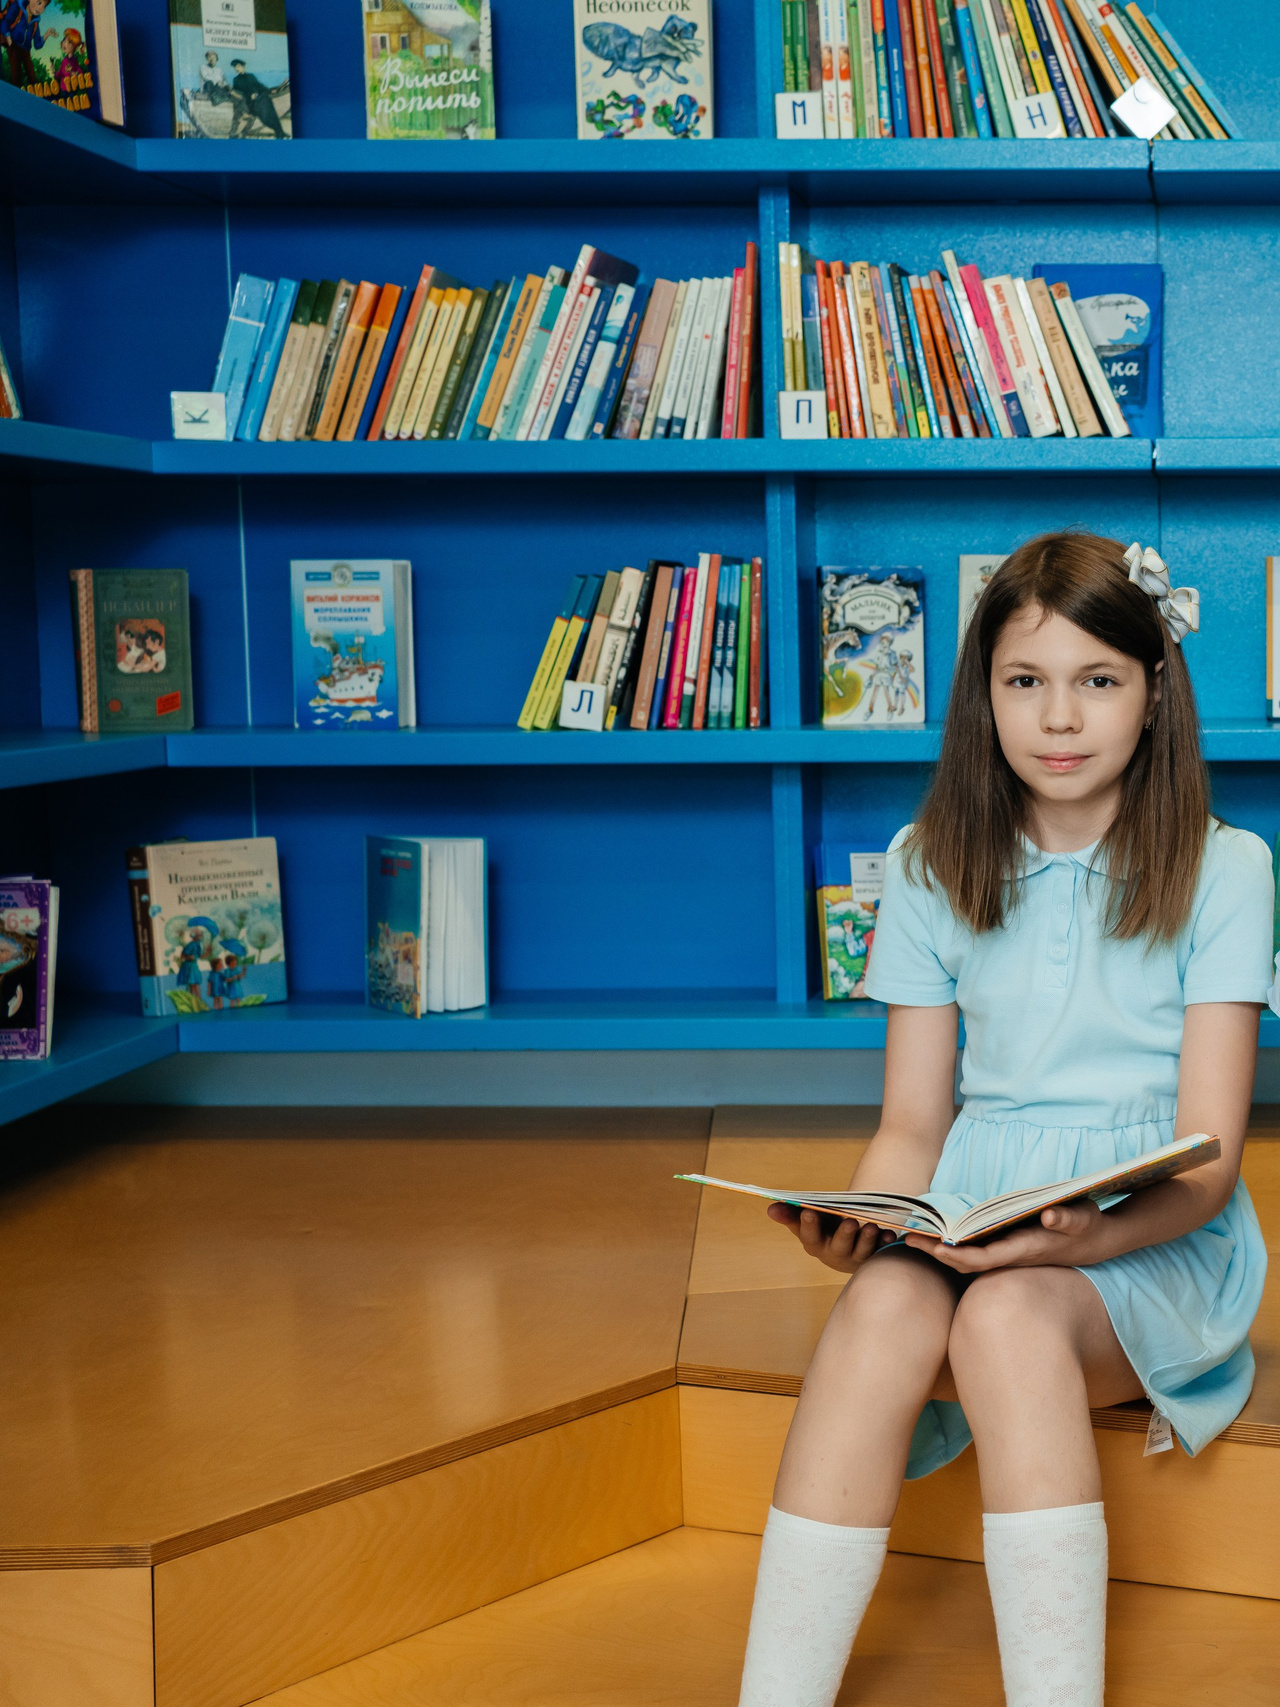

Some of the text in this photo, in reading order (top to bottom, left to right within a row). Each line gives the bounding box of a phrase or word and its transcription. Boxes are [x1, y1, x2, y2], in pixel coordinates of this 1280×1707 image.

[379, 57, 480, 94] Вынеси
[376, 94, 481, 115] попить
[792, 101, 807, 125] М
[1026, 103, 1047, 130] Н
[183, 409, 209, 424] К
[795, 399, 812, 424] П
[571, 689, 594, 714] Л
[5, 912, 33, 931] 6+
